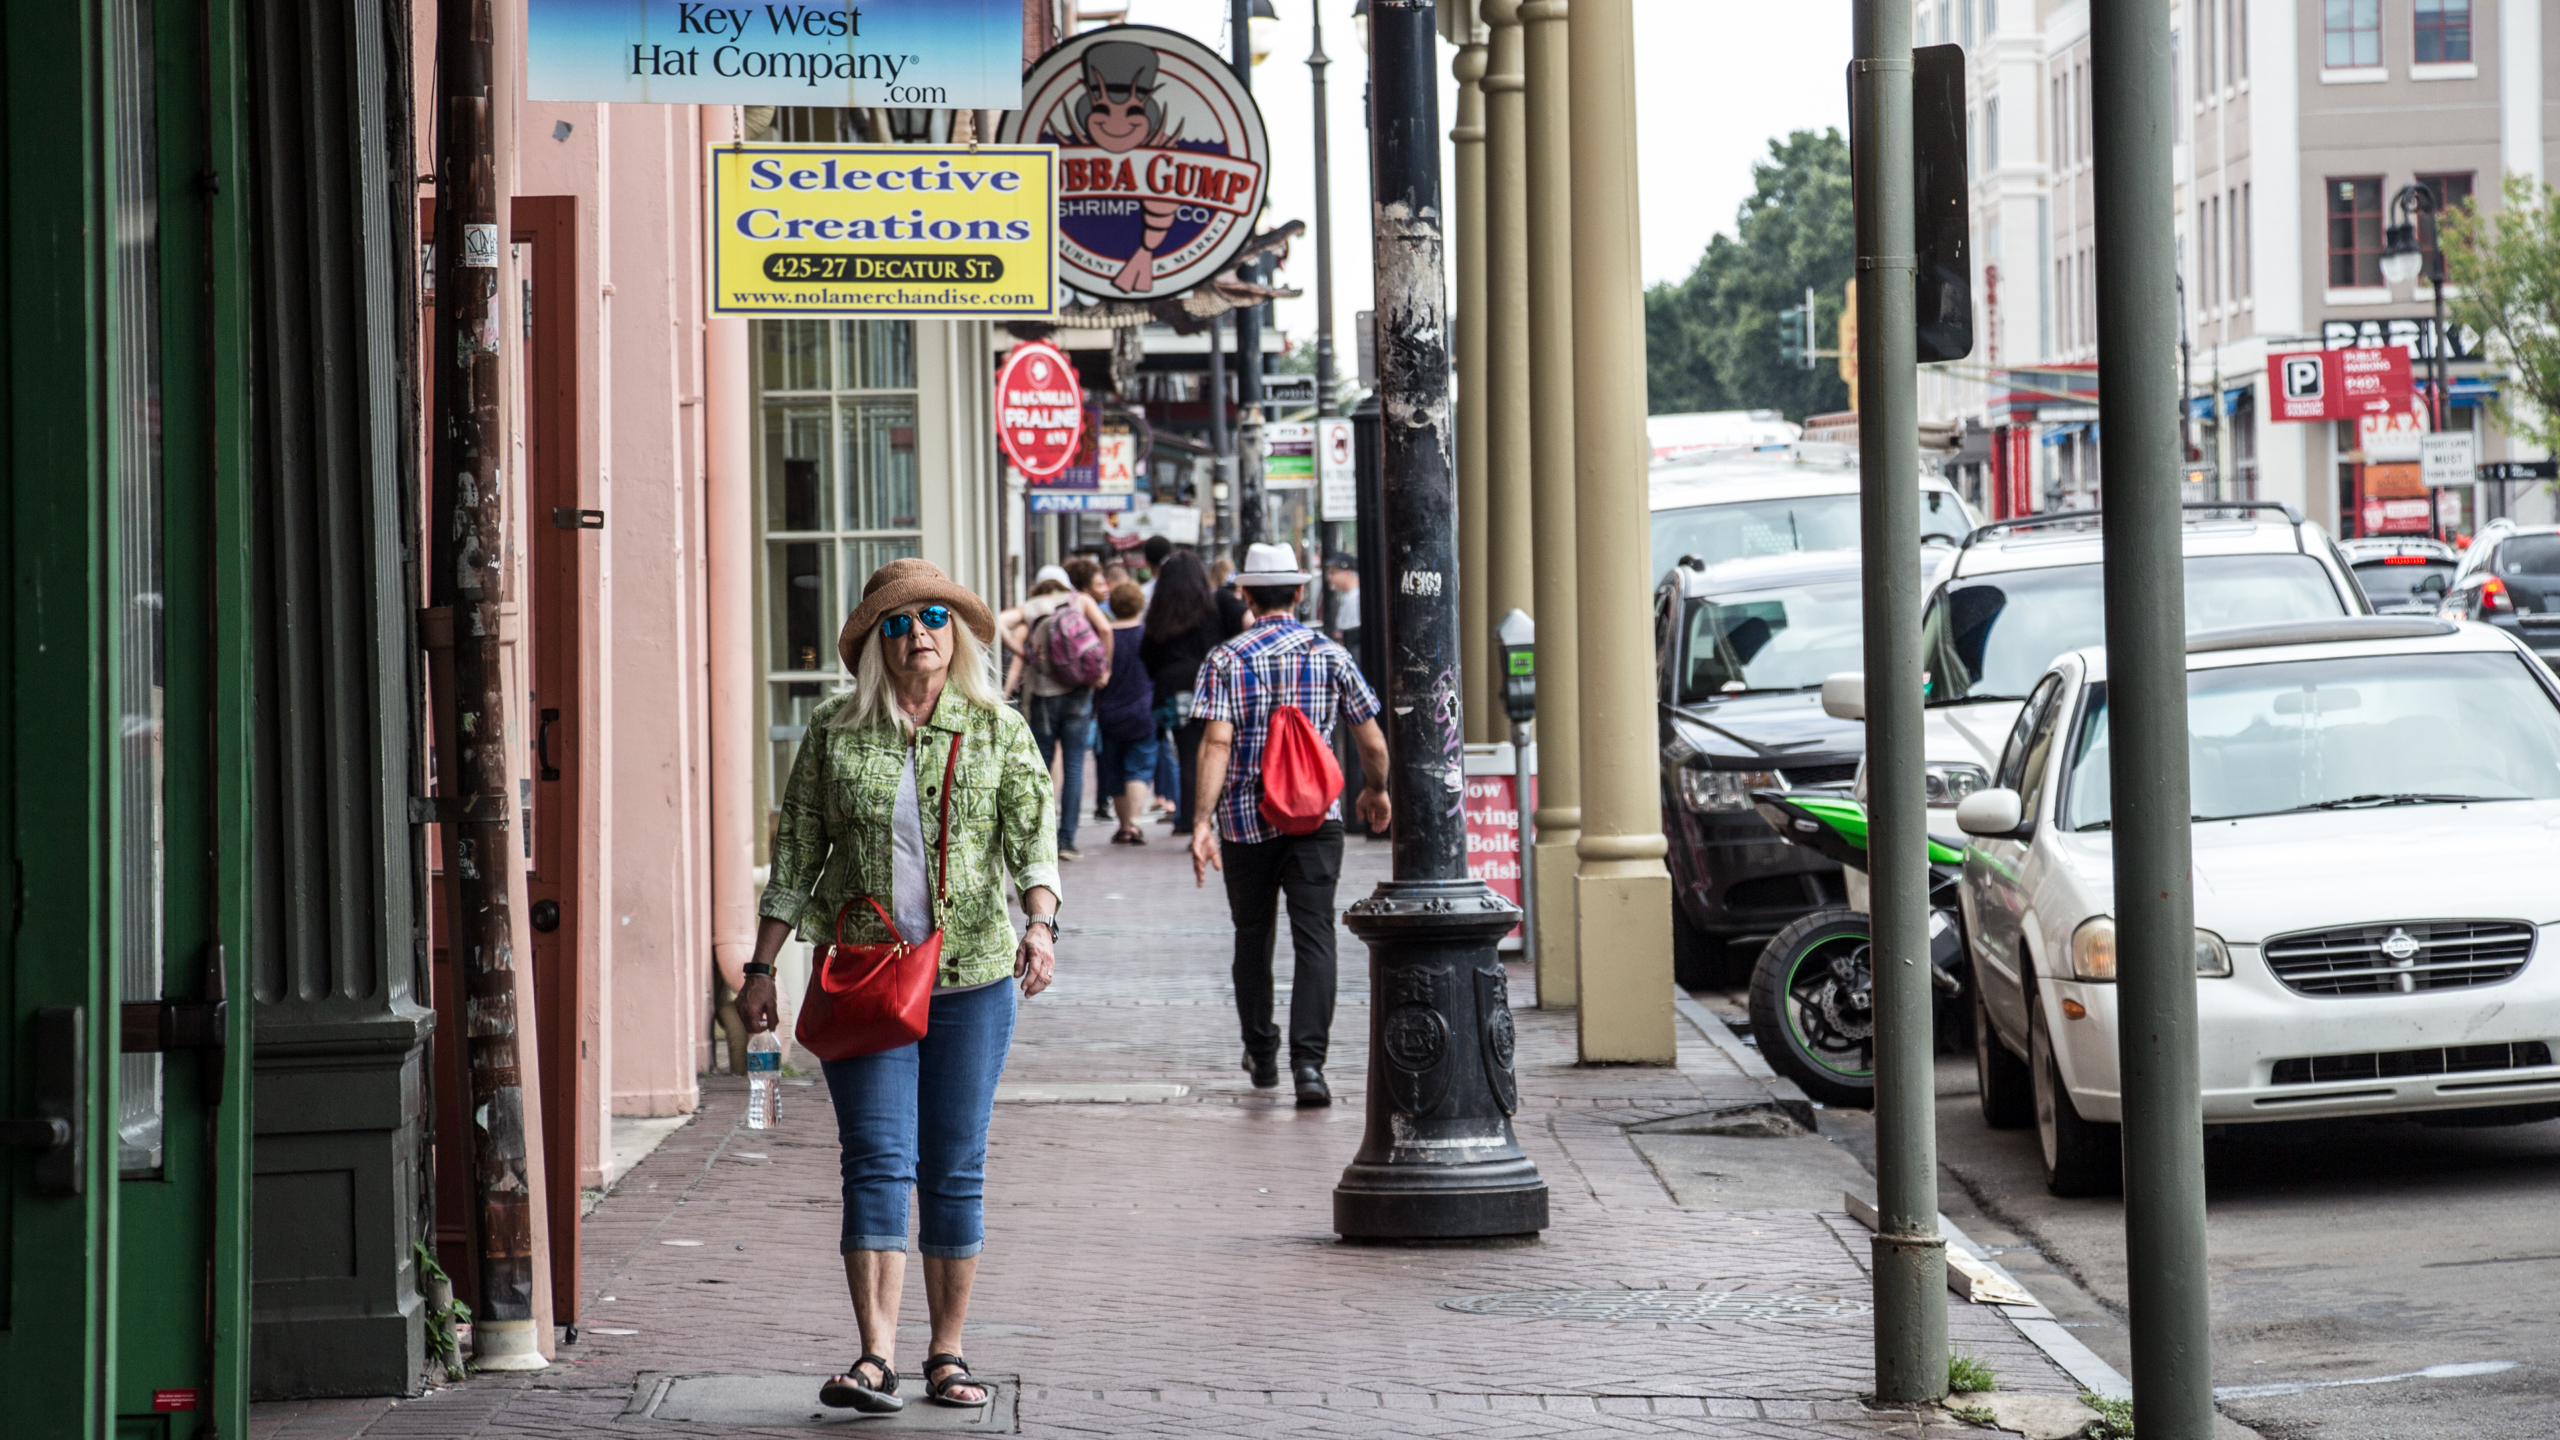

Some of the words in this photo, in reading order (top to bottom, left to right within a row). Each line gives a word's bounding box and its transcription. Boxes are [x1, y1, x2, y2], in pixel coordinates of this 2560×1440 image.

[678, 3, 752, 42] Key
[765, 4, 862, 36] West
[632, 44, 699, 76] Hat
[883, 86, 947, 103] .com
[750, 159, 1020, 191] Selective
[1060, 157, 1138, 192] BBA
[1146, 153, 1251, 205] GUMP
[736, 209, 1030, 240] Creations
[1060, 238, 1116, 273] AURANT
[1174, 216, 1227, 266] MARKET
[772, 258, 847, 278] 425-27
[855, 259, 959, 279] DECATUR
[733, 288, 1035, 305] www.nolamerchandise.com
[2344, 359, 2391, 372] PARKING
[1005, 408, 1079, 428] PRALINE
[2425, 441, 2447, 449] RIGHT
[2435, 454, 2462, 464] MUST
[1034, 495, 1082, 511] ATM
[1467, 806, 1519, 830] rving
[1467, 833, 1536, 853] Boile
[1468, 860, 1521, 879] wfish
[2386, 941, 2415, 949] NISSAN
